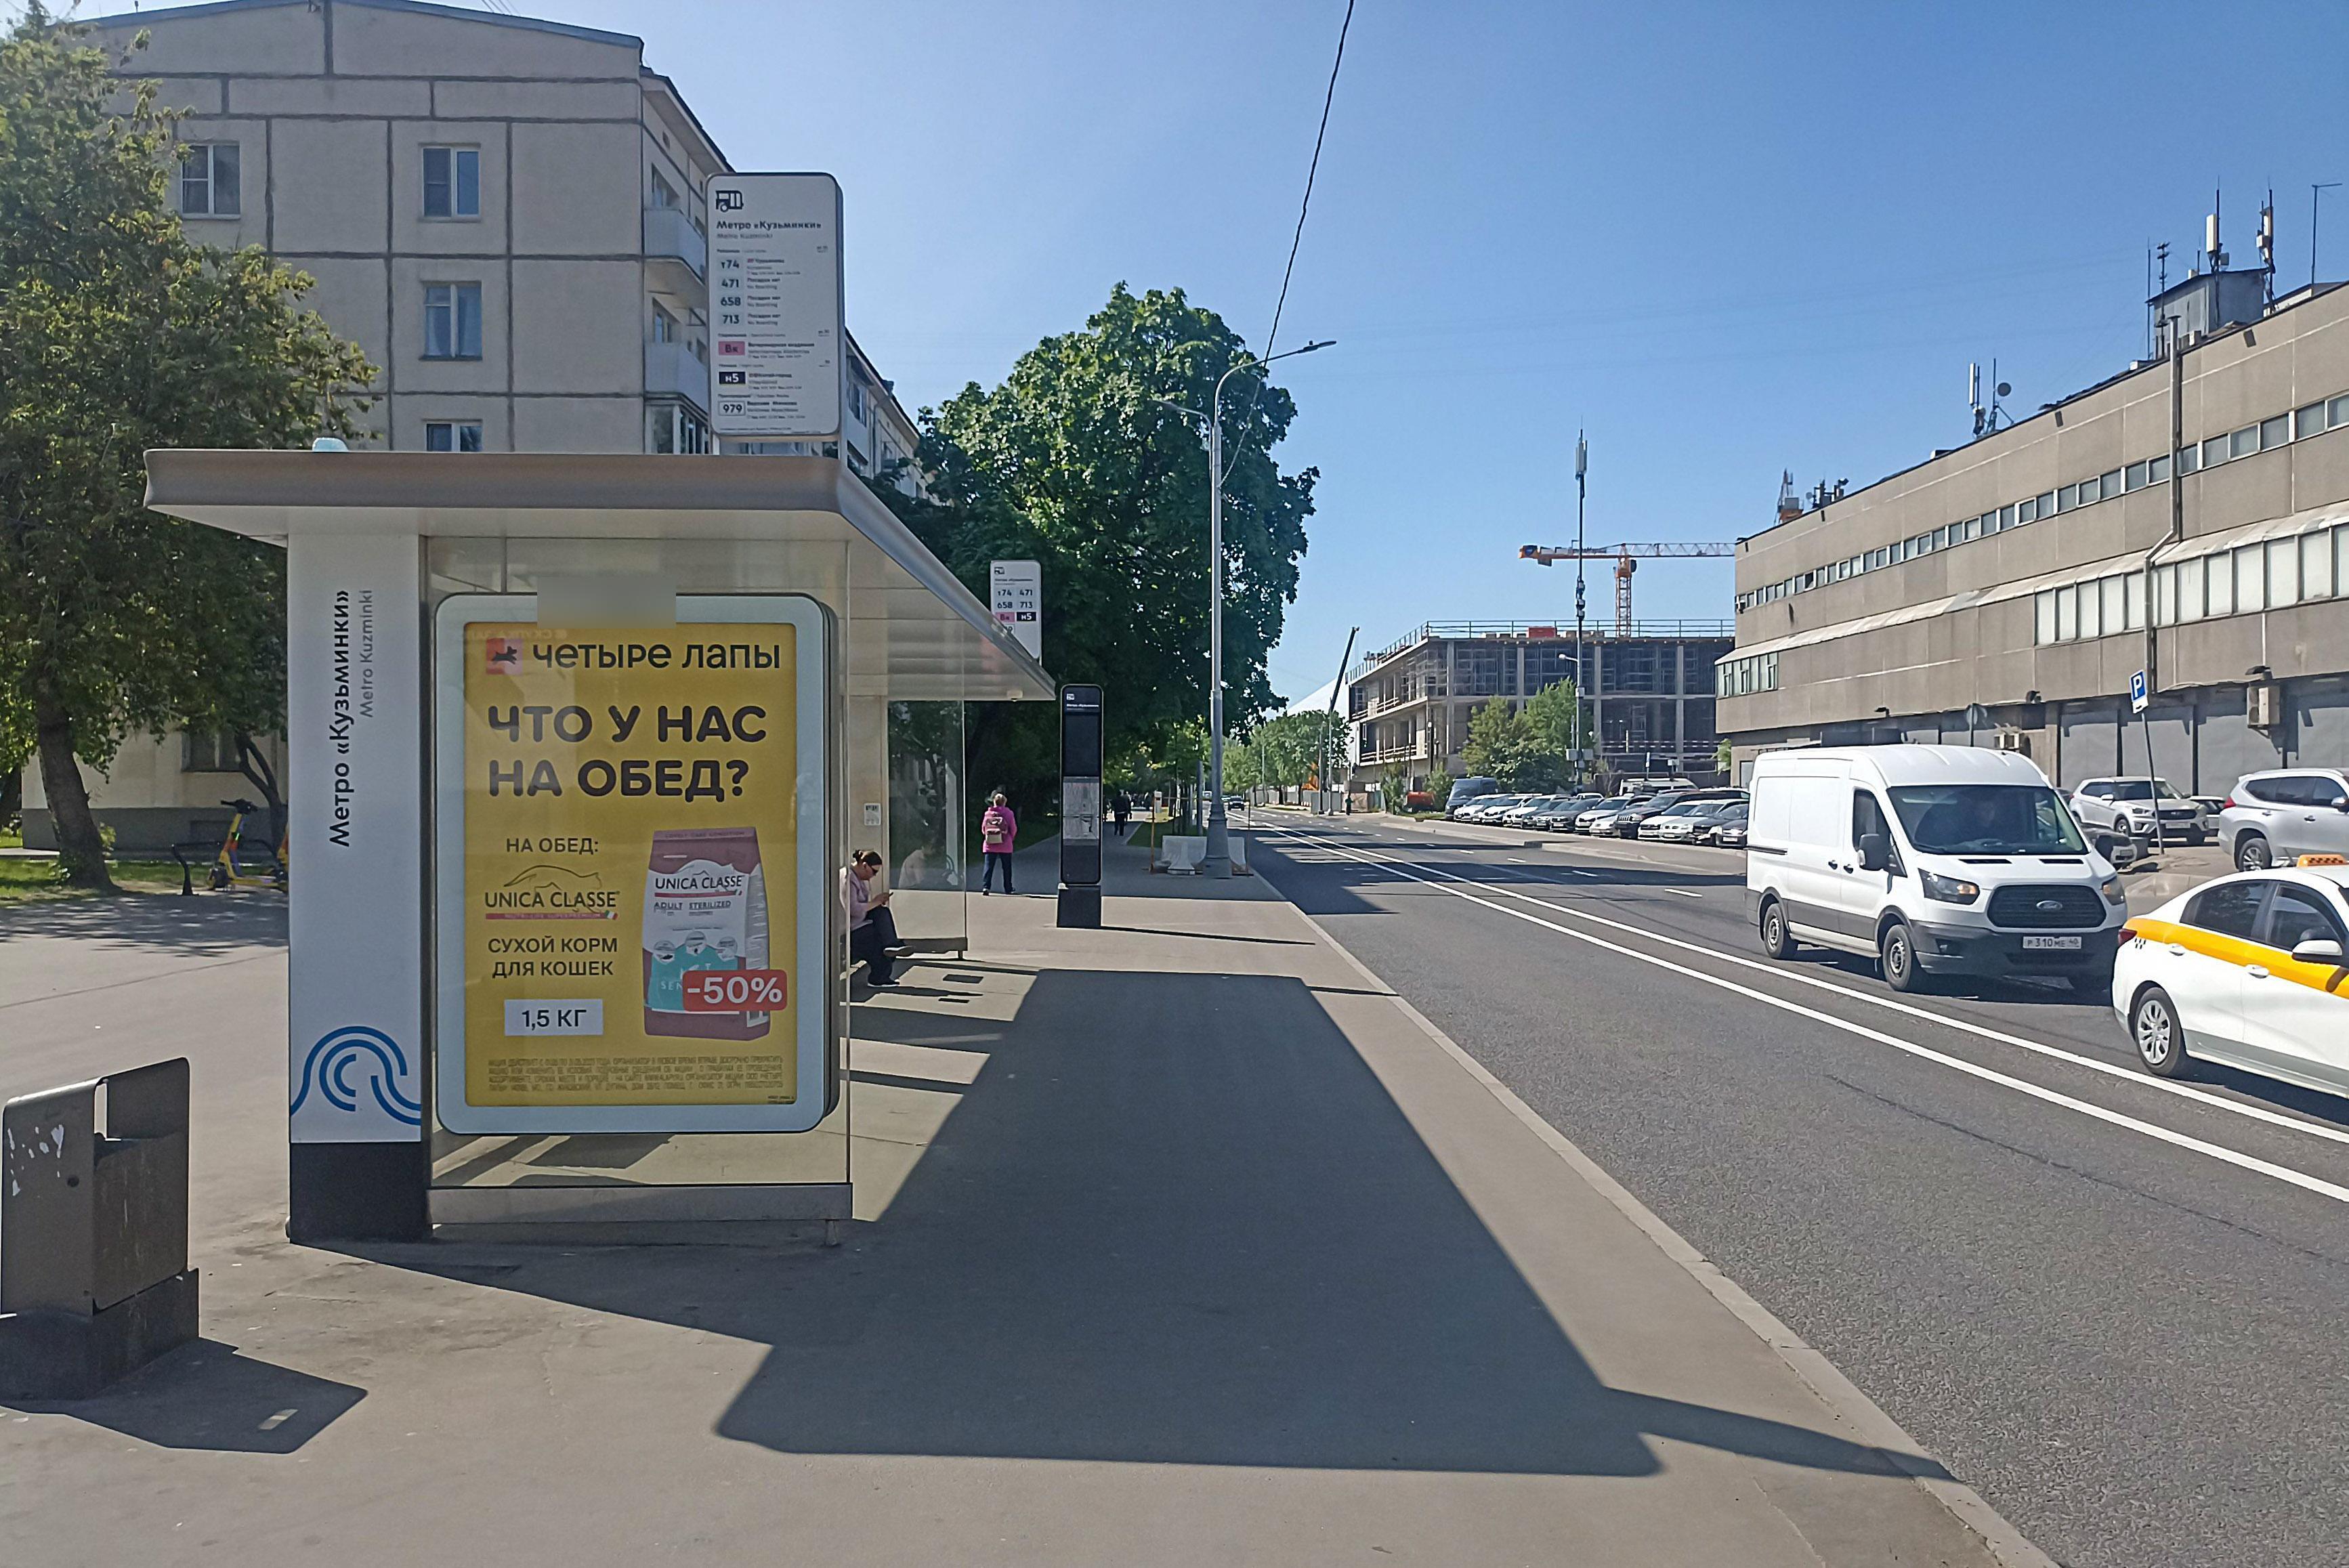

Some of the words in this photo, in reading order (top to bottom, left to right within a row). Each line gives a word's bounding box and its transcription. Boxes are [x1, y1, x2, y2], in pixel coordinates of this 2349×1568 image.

[716, 221, 751, 231] Метро
[754, 221, 821, 231] «Кузьминки»
[721, 278, 740, 288] 471
[721, 297, 741, 305] 658
[723, 315, 740, 324] 713
[723, 404, 742, 413] 979
[359, 589, 373, 662] Kuzminki
[532, 644, 672, 669] четыре
[681, 644, 780, 669] лапы
[329, 590, 354, 755] «Кузьминки»
[360, 667, 374, 717] Metro
[2133, 674, 2142, 698] P
[488, 705, 593, 742] ЧТО
[608, 705, 641, 742] У
[658, 705, 767, 742] НАС
[488, 759, 562, 797] НА
[578, 759, 749, 803] ОБЕД?
[329, 763, 354, 847] Метро
[506, 838, 534, 852] НА
[538, 837, 599, 854] ОБЕД:
[656, 878, 698, 889] UNICA
[702, 875, 742, 889] CLASSE
[485, 892, 545, 908] UNICA
[550, 891, 617, 908] CLASSE
[654, 902, 683, 910] ADULT
[689, 900, 732, 910] STERILIZED
[488, 935, 555, 952] СУХОЙ
[561, 937, 618, 952] КОРМ
[492, 961, 534, 978] ДЛЯ
[541, 961, 614, 976] КОШЕК
[687, 976, 782, 1004] -50%
[521, 1009, 550, 1030] 1,5
[557, 1009, 587, 1027] КГ
